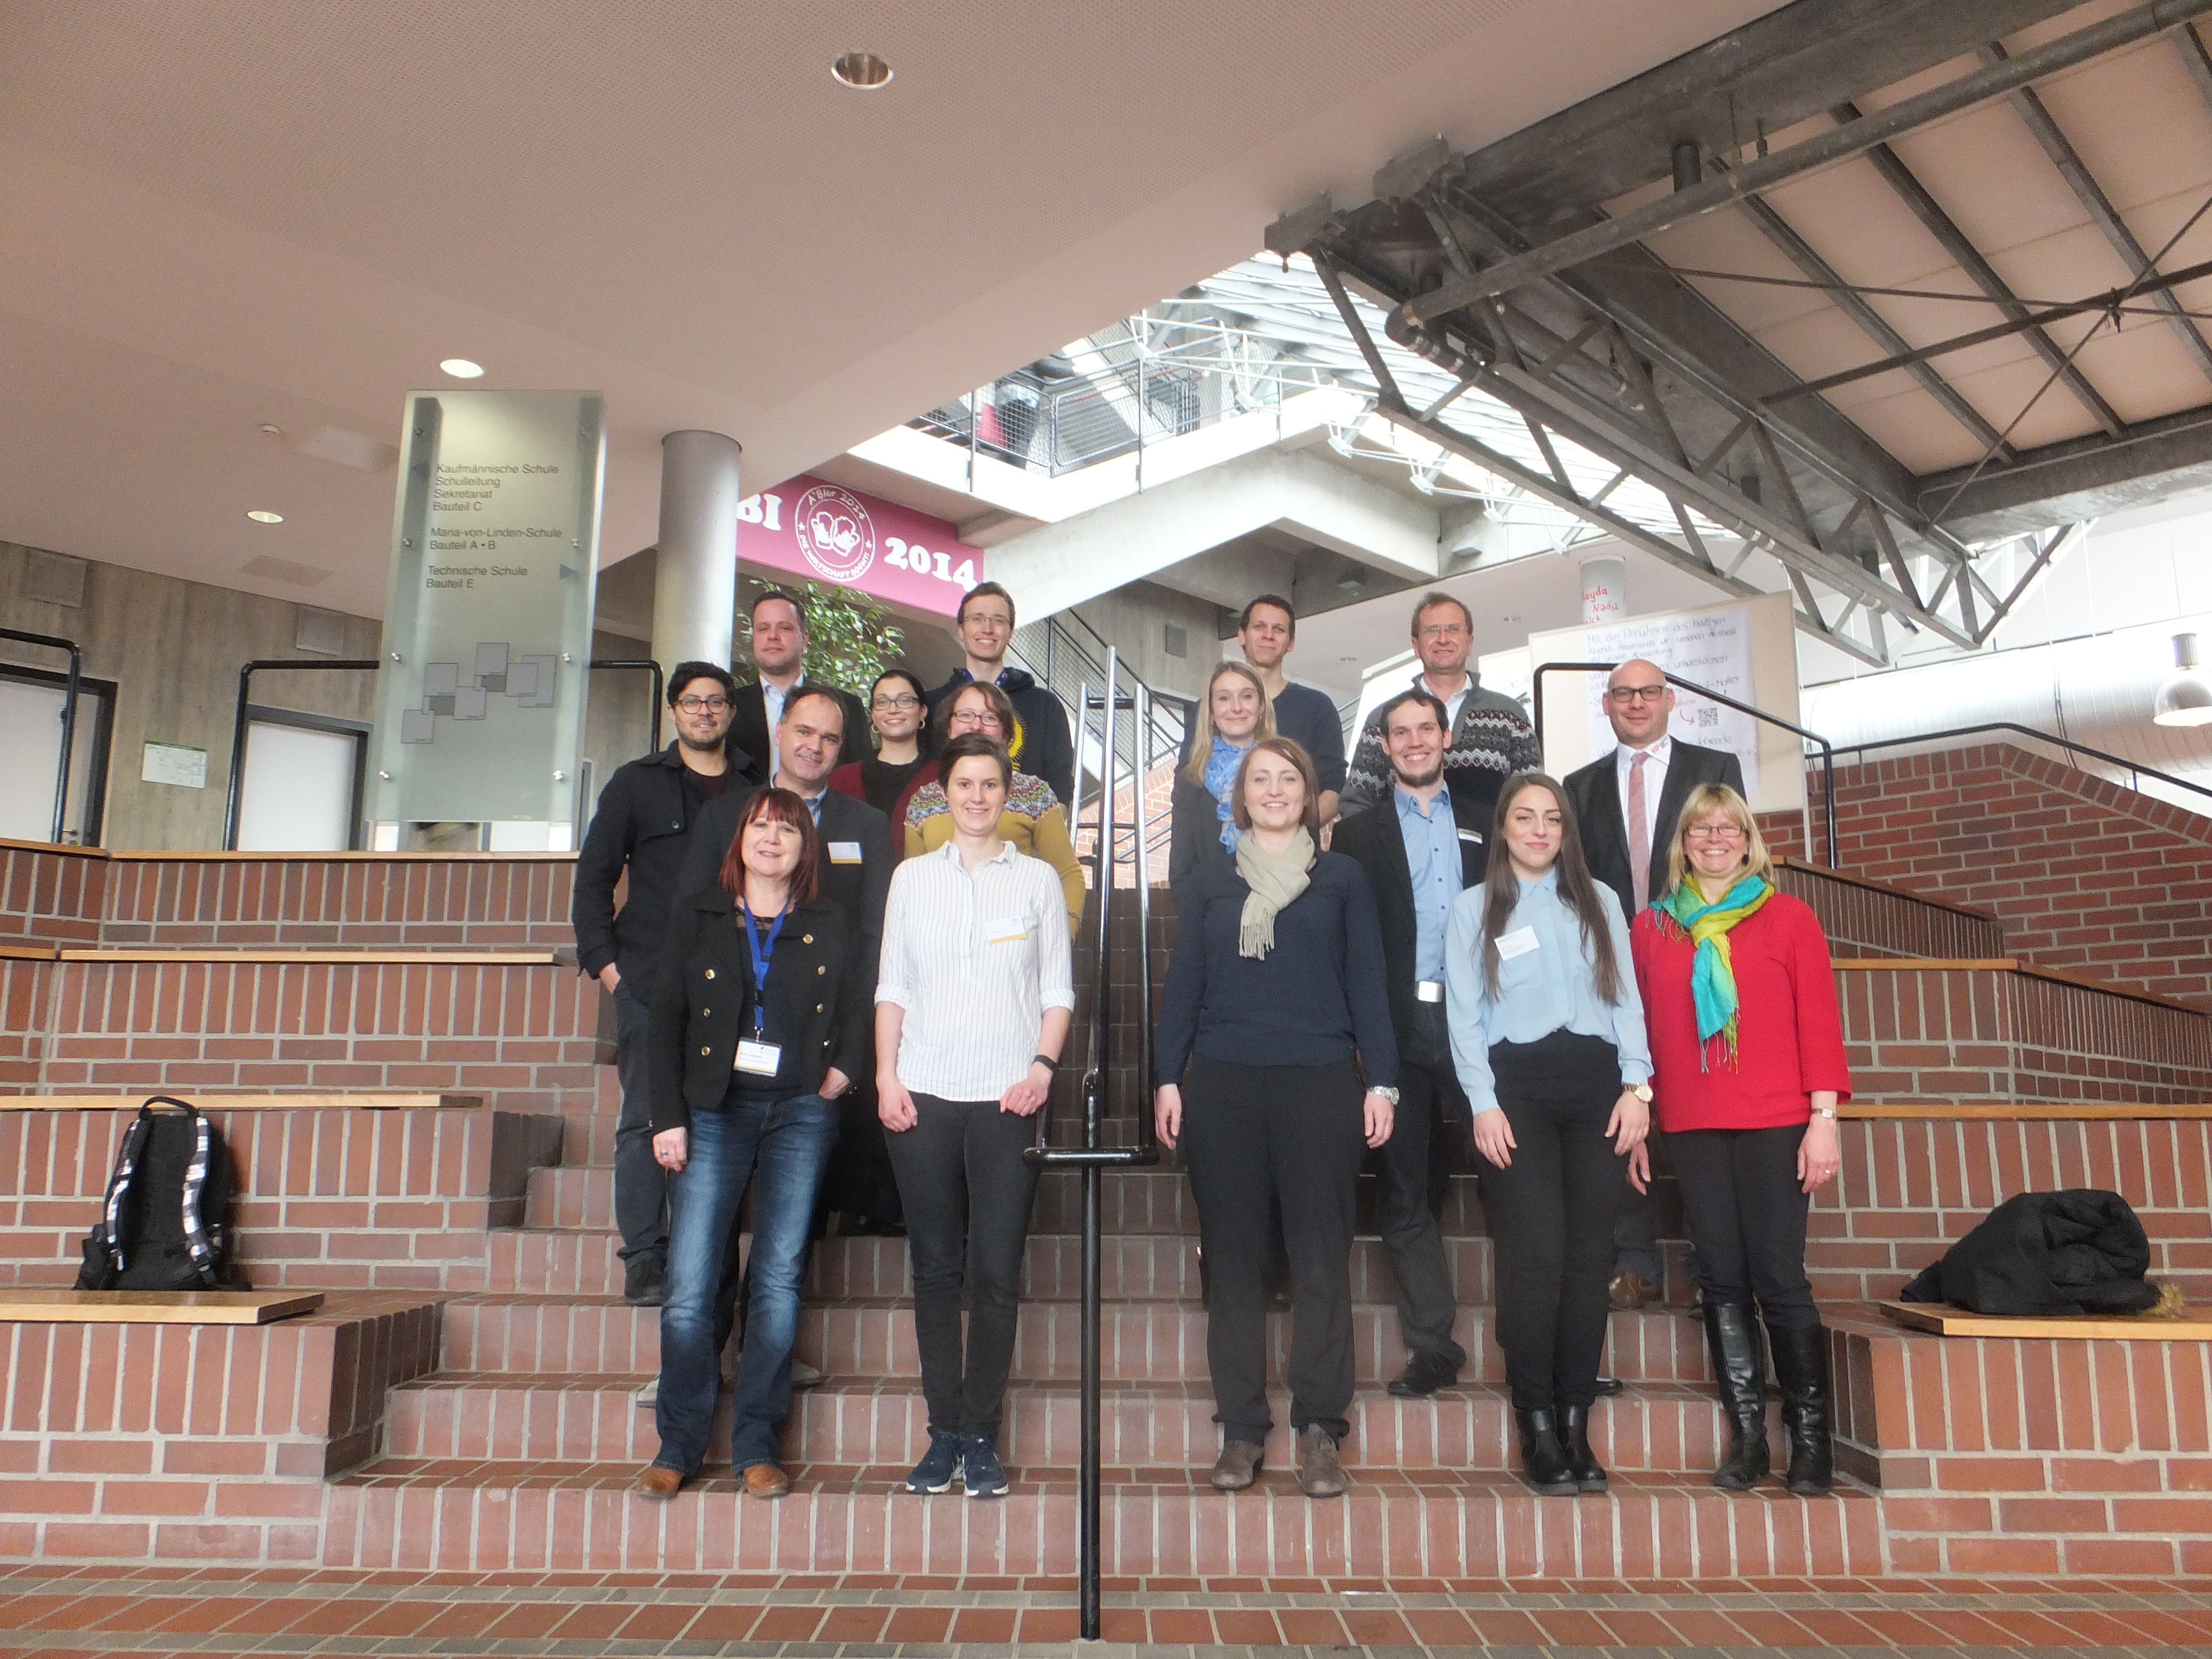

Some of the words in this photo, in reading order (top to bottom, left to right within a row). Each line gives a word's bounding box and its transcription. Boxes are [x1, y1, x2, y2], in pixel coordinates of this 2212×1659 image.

[437, 464, 519, 474] Kaufmännische
[522, 464, 558, 474] Schule
[436, 476, 501, 488] Schulleitung
[434, 489, 493, 498] Sekretariat
[433, 501, 470, 511] Bauteil
[473, 501, 482, 511] C
[431, 527, 562, 538] Maria-von-Linden-Schule
[430, 540, 467, 550] Bauteil
[470, 541, 478, 550] A
[488, 540, 496, 550] B
[799, 534, 810, 550] DIE
[807, 550, 850, 578] WIRTSCHAFT
[884, 537, 978, 592] 2014
[428, 565, 488, 576] Technische
[491, 565, 528, 576] Schule
[426, 578, 463, 589] Bauteil
[466, 578, 474, 589] E
